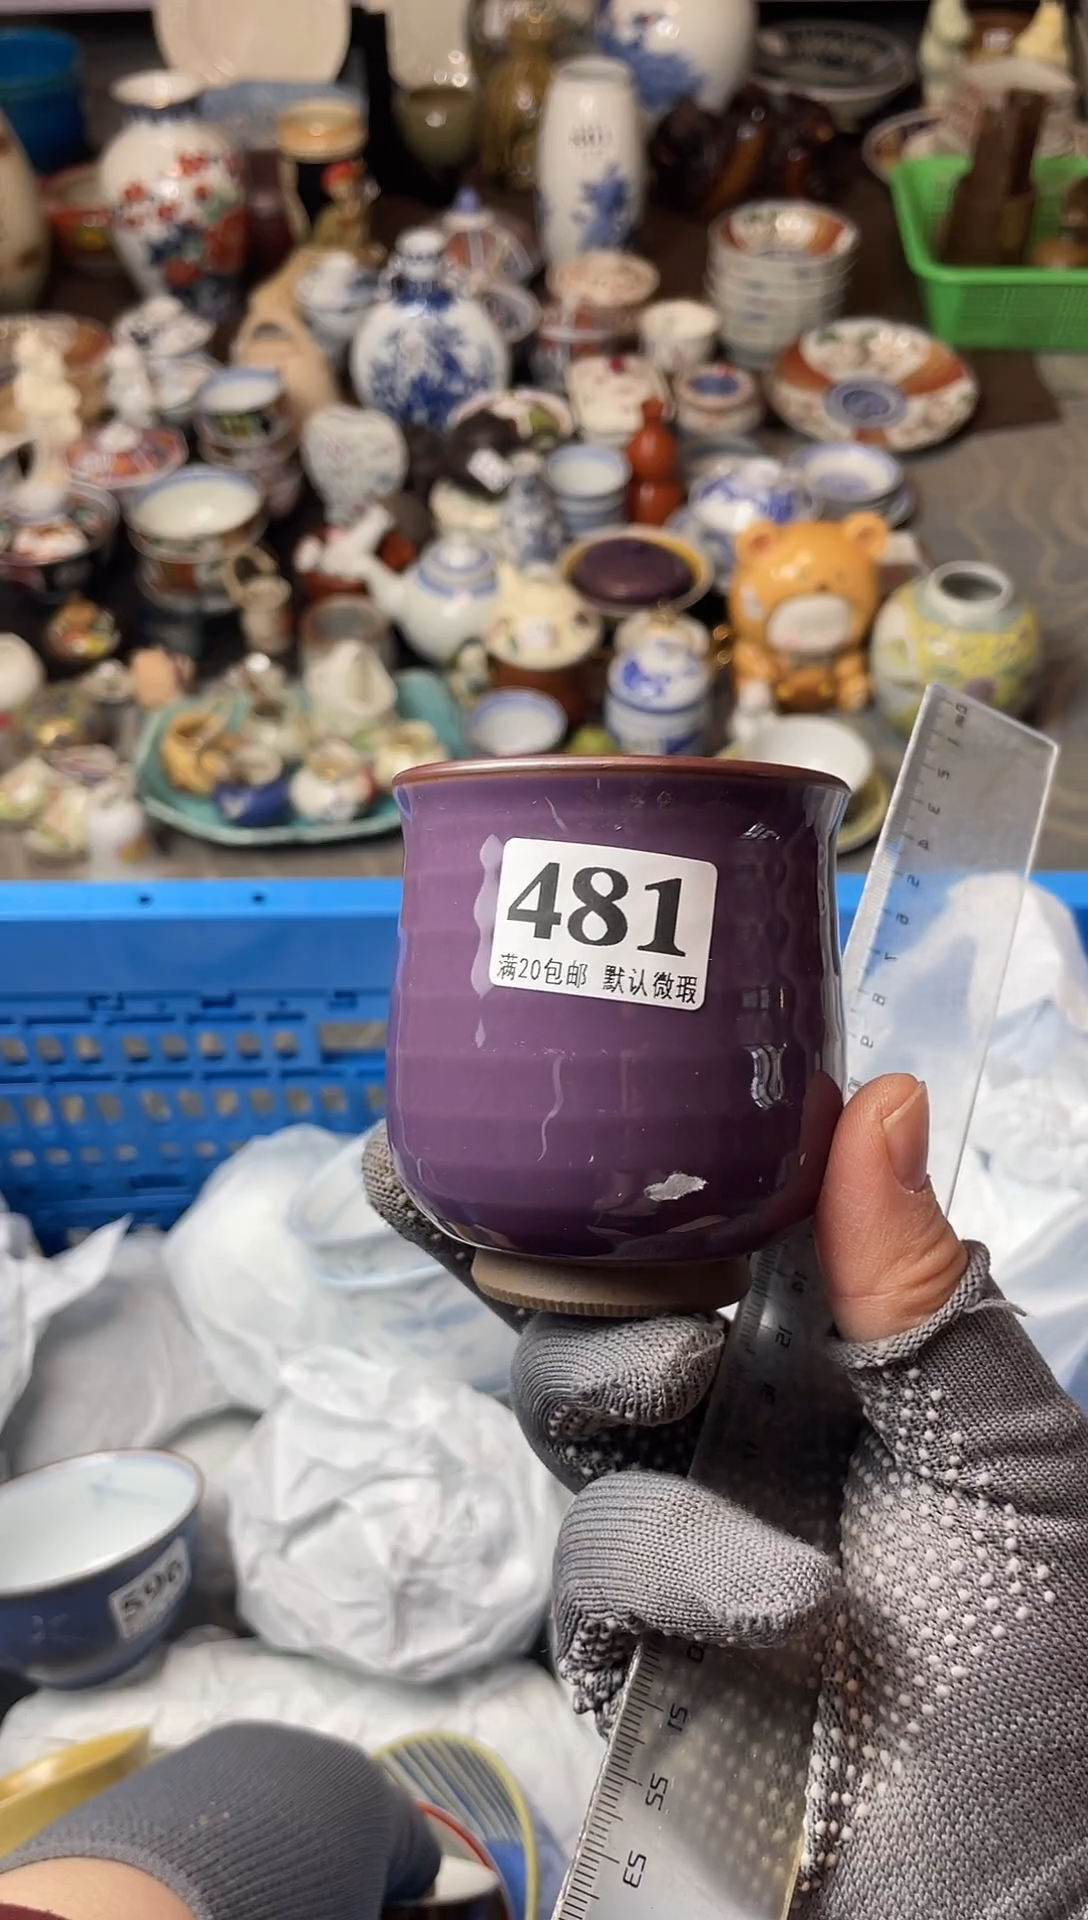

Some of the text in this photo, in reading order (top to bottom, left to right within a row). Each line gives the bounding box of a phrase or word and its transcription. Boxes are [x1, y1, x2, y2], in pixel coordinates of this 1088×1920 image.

[506, 861, 687, 958] 481
[496, 952, 699, 1005] 满20包邮 默认微瑕
